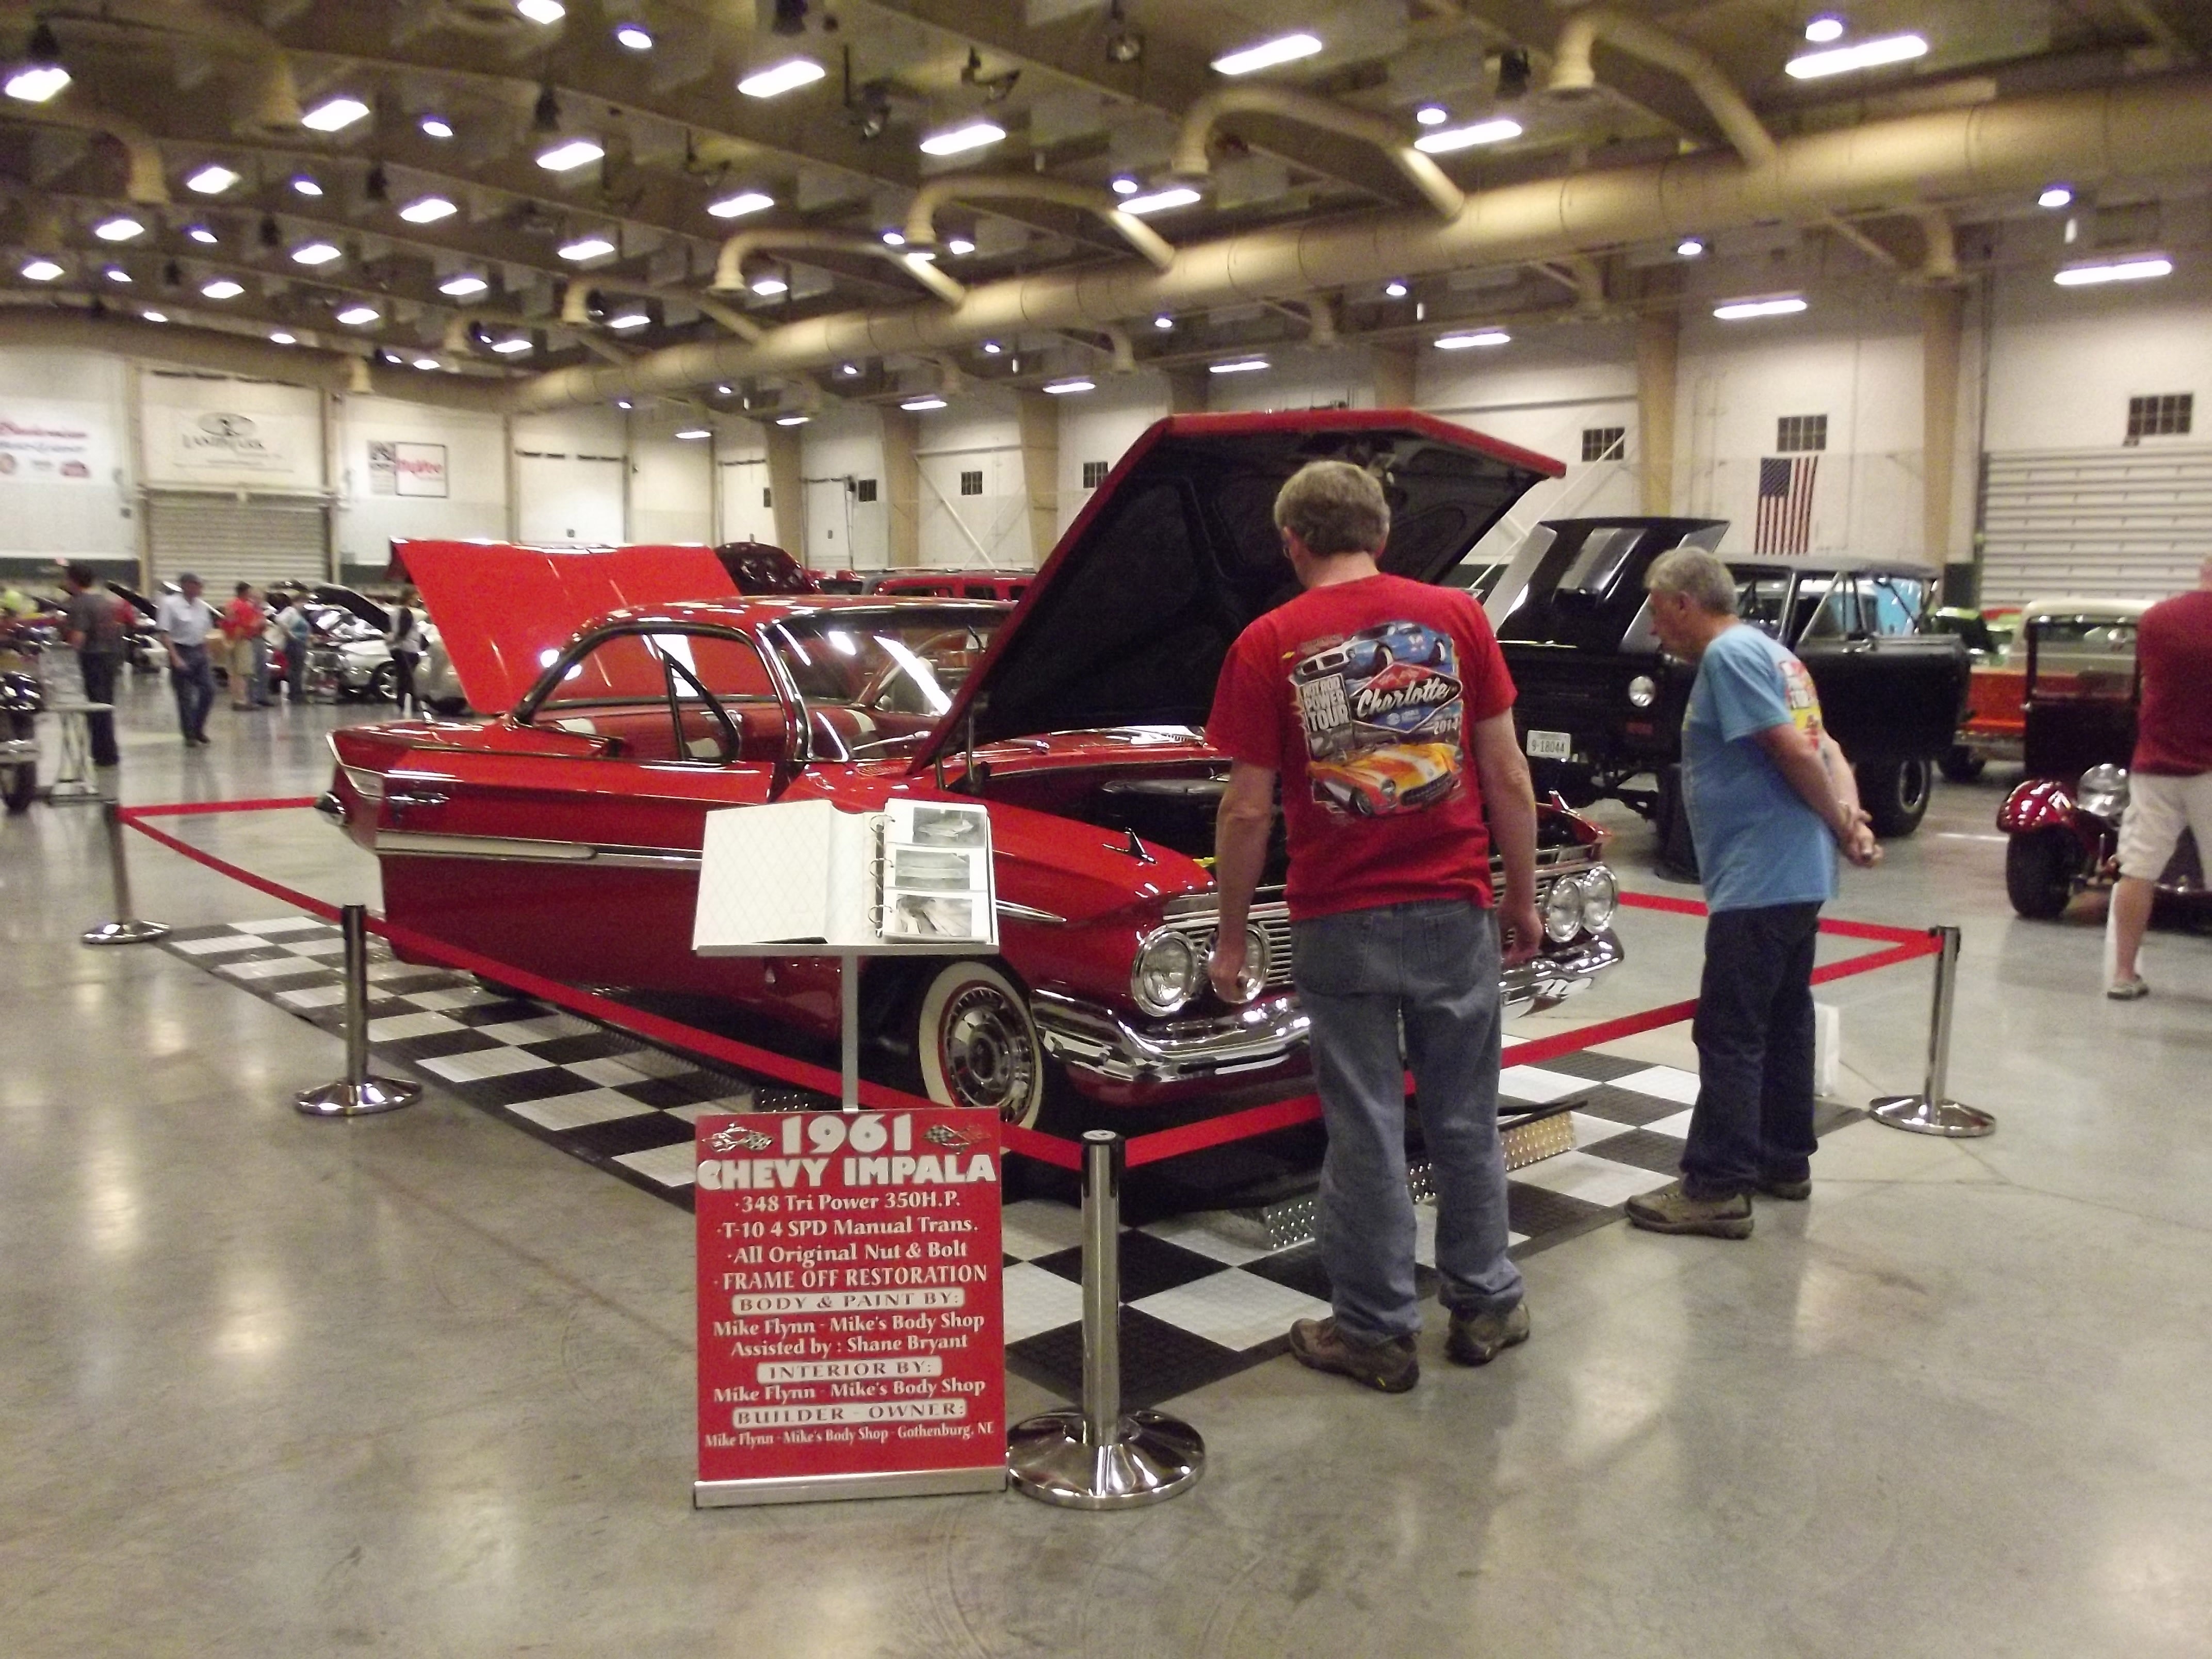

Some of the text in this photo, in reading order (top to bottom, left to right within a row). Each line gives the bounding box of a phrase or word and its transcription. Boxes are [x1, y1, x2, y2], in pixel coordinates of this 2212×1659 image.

[1304, 689, 1345, 711] POWER
[1357, 677, 1450, 718] Charlotte
[1308, 704, 1350, 731] TOUR
[782, 1114, 911, 1154] 1961
[697, 1154, 996, 1190] CHEVY IMPALA
[742, 1191, 960, 1212] 348 Tri Power 350H.P.
[723, 1216, 978, 1238] T-10 4 SPD Manual Trans.
[734, 1240, 967, 1268] All Original Nut & Bolt
[724, 1264, 987, 1290] FRAME OFF RESTORATION
[740, 1291, 959, 1311] BODY & PAINT BY:
[713, 1320, 758, 1337] Mike
[764, 1318, 816, 1340] Flynn
[830, 1316, 886, 1332] Mike's
[892, 1312, 936, 1334] Body
[940, 1312, 985, 1332] Shop
[731, 1339, 805, 1356] Assisted
[847, 1337, 902, 1351] Shane
[908, 1334, 968, 1354] Bryant
[769, 1361, 932, 1379] INTERIOR BY:
[714, 1387, 759, 1403] Mike
[765, 1385, 816, 1404] Flynn
[831, 1382, 887, 1397] Mike's
[893, 1378, 936, 1398] Body
[941, 1378, 985, 1396] Shop
[739, 1407, 844, 1424] BUILDER
[868, 1403, 965, 1419] OWNER:
[706, 1433, 736, 1447] Mike
[738, 1432, 773, 1450] Flynn
[783, 1429, 822, 1443] Mike's
[825, 1428, 856, 1445] Body
[858, 1427, 888, 1444] Shop
[978, 1422, 995, 1434] NE
